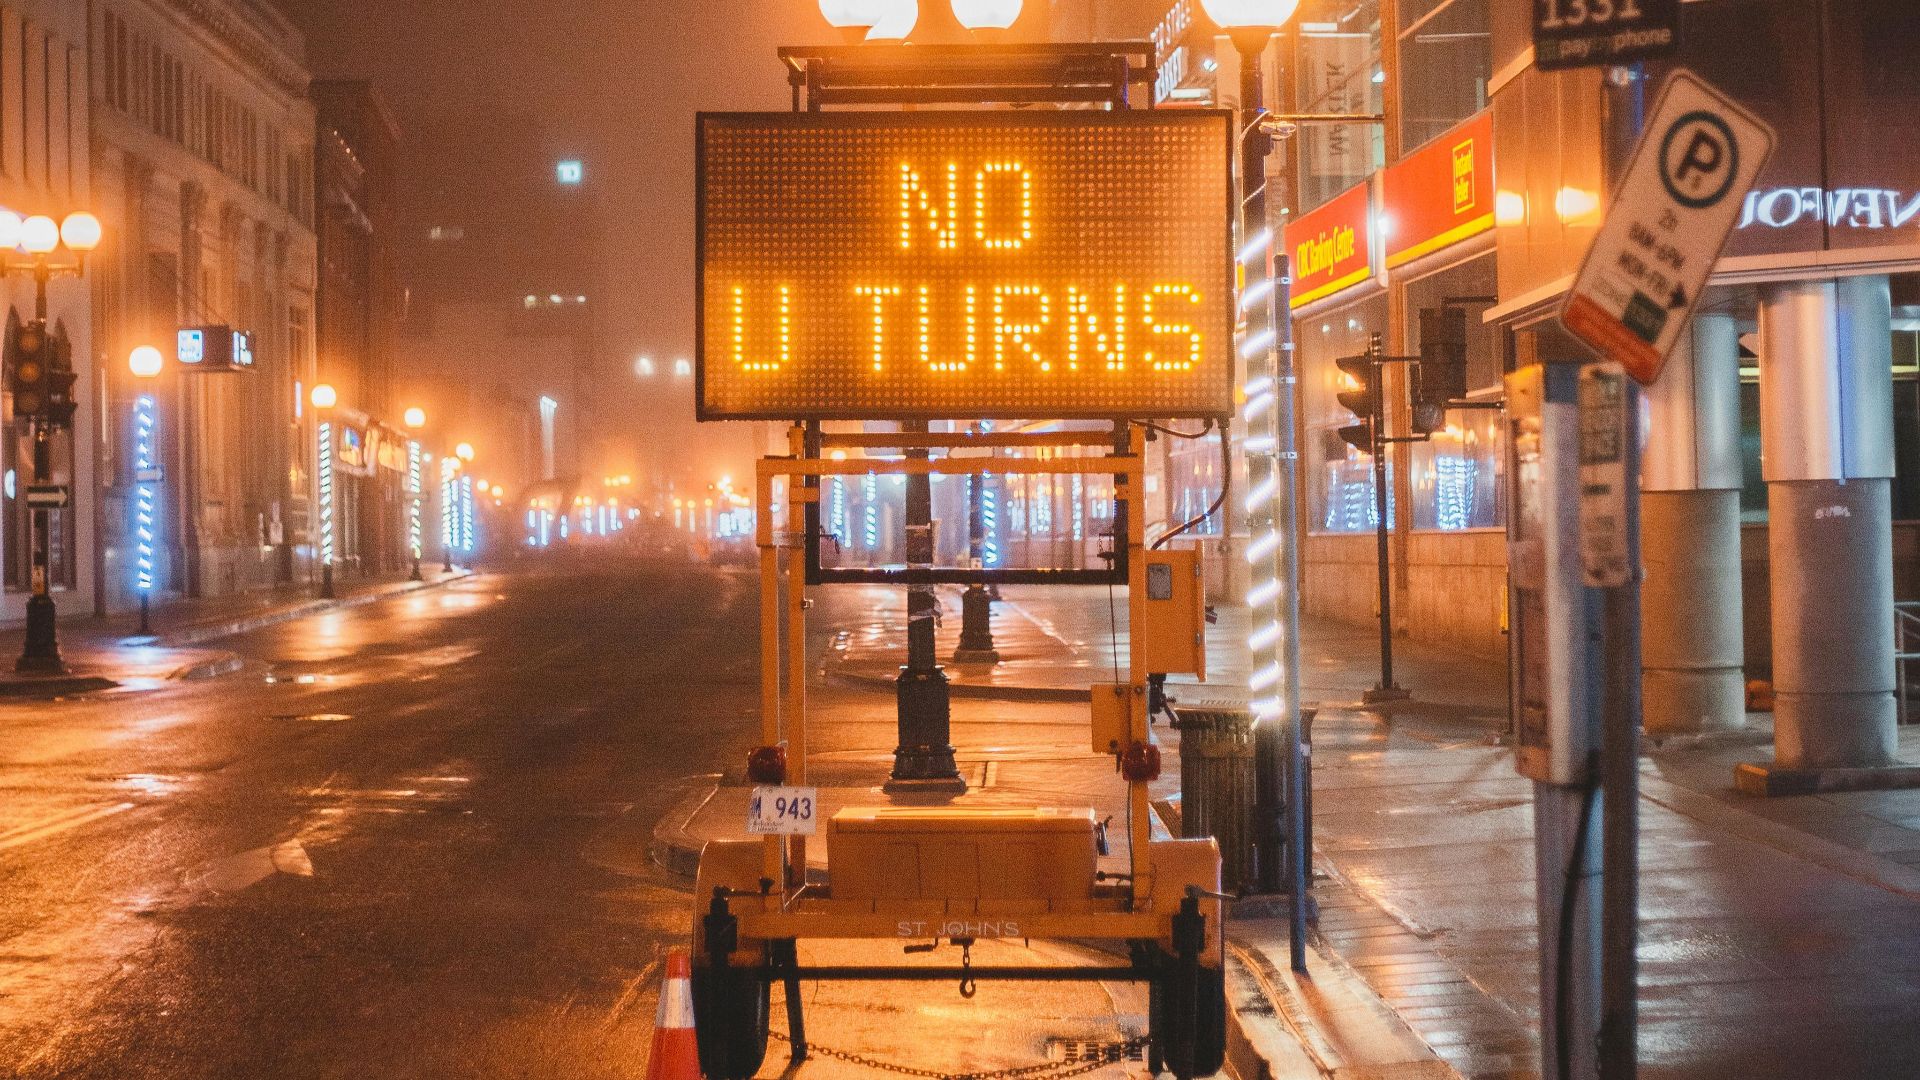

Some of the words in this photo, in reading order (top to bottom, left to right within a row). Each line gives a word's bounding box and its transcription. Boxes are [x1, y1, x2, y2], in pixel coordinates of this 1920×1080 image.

[1674, 128, 1722, 181] P
[900, 162, 1032, 249] NO
[1310, 231, 1334, 276] Banking
[1333, 224, 1355, 263] Centre
[733, 285, 789, 372] U
[854, 284, 1202, 372] TURNS
[775, 796, 811, 820] 943
[937, 920, 1019, 937] JOHN'S
